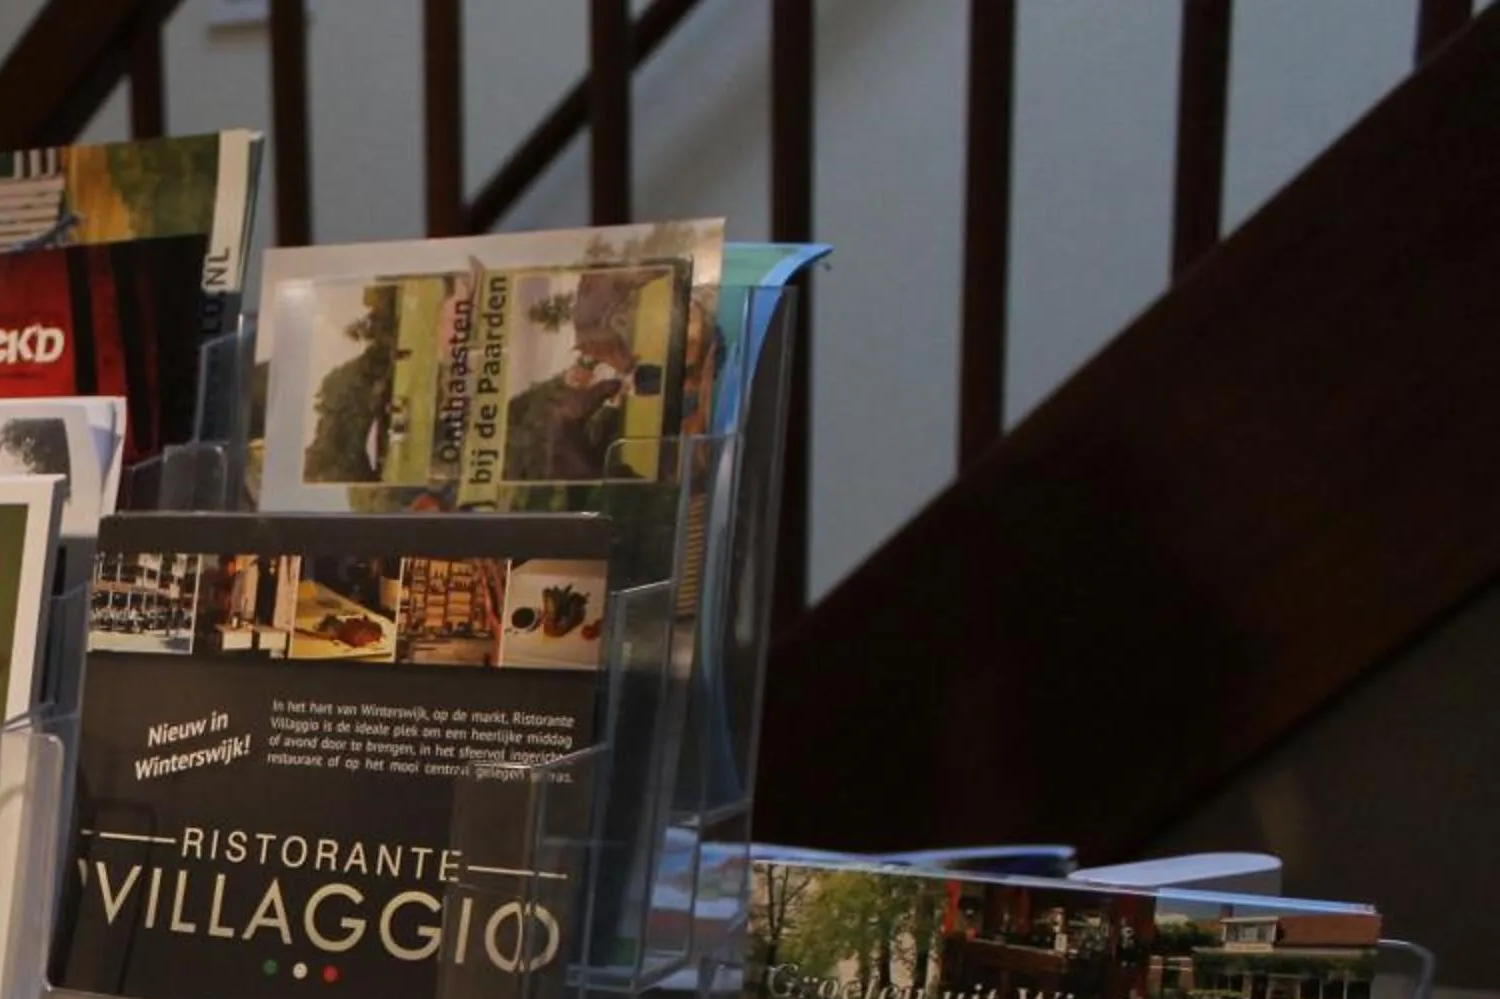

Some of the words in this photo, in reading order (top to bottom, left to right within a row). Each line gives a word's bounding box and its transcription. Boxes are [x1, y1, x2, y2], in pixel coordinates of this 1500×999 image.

[477, 276, 507, 395] Paarden
[476, 403, 498, 439] de
[469, 448, 499, 485] bij
[147, 716, 207, 747] Nieuw
[211, 711, 229, 732] in
[272, 699, 284, 712] In
[287, 699, 306, 713] het
[310, 700, 333, 714] hart
[338, 703, 357, 716] van
[433, 709, 449, 723] op
[453, 708, 468, 721] de
[513, 710, 575, 728] Ristorante
[269, 733, 280, 746] of
[284, 734, 317, 749] avond
[321, 736, 347, 750] door
[352, 738, 363, 751] te
[420, 742, 431, 755] in
[435, 744, 455, 758] het
[270, 716, 320, 734] Villaggio
[324, 718, 333, 732] is
[338, 720, 352, 733] de
[356, 721, 390, 736] ideale
[423, 727, 442, 739] om
[446, 728, 467, 741] een
[471, 729, 523, 747] heerlijke
[528, 731, 573, 750] middag
[135, 733, 251, 780] Winterswijk!
[267, 752, 322, 768] restaurant
[327, 754, 339, 768] of
[345, 758, 360, 771] op
[365, 757, 385, 771] het
[390, 760, 419, 774] mooi
[181, 827, 464, 882] RISTORANTE
[95, 861, 561, 973] VILLAGGIO
